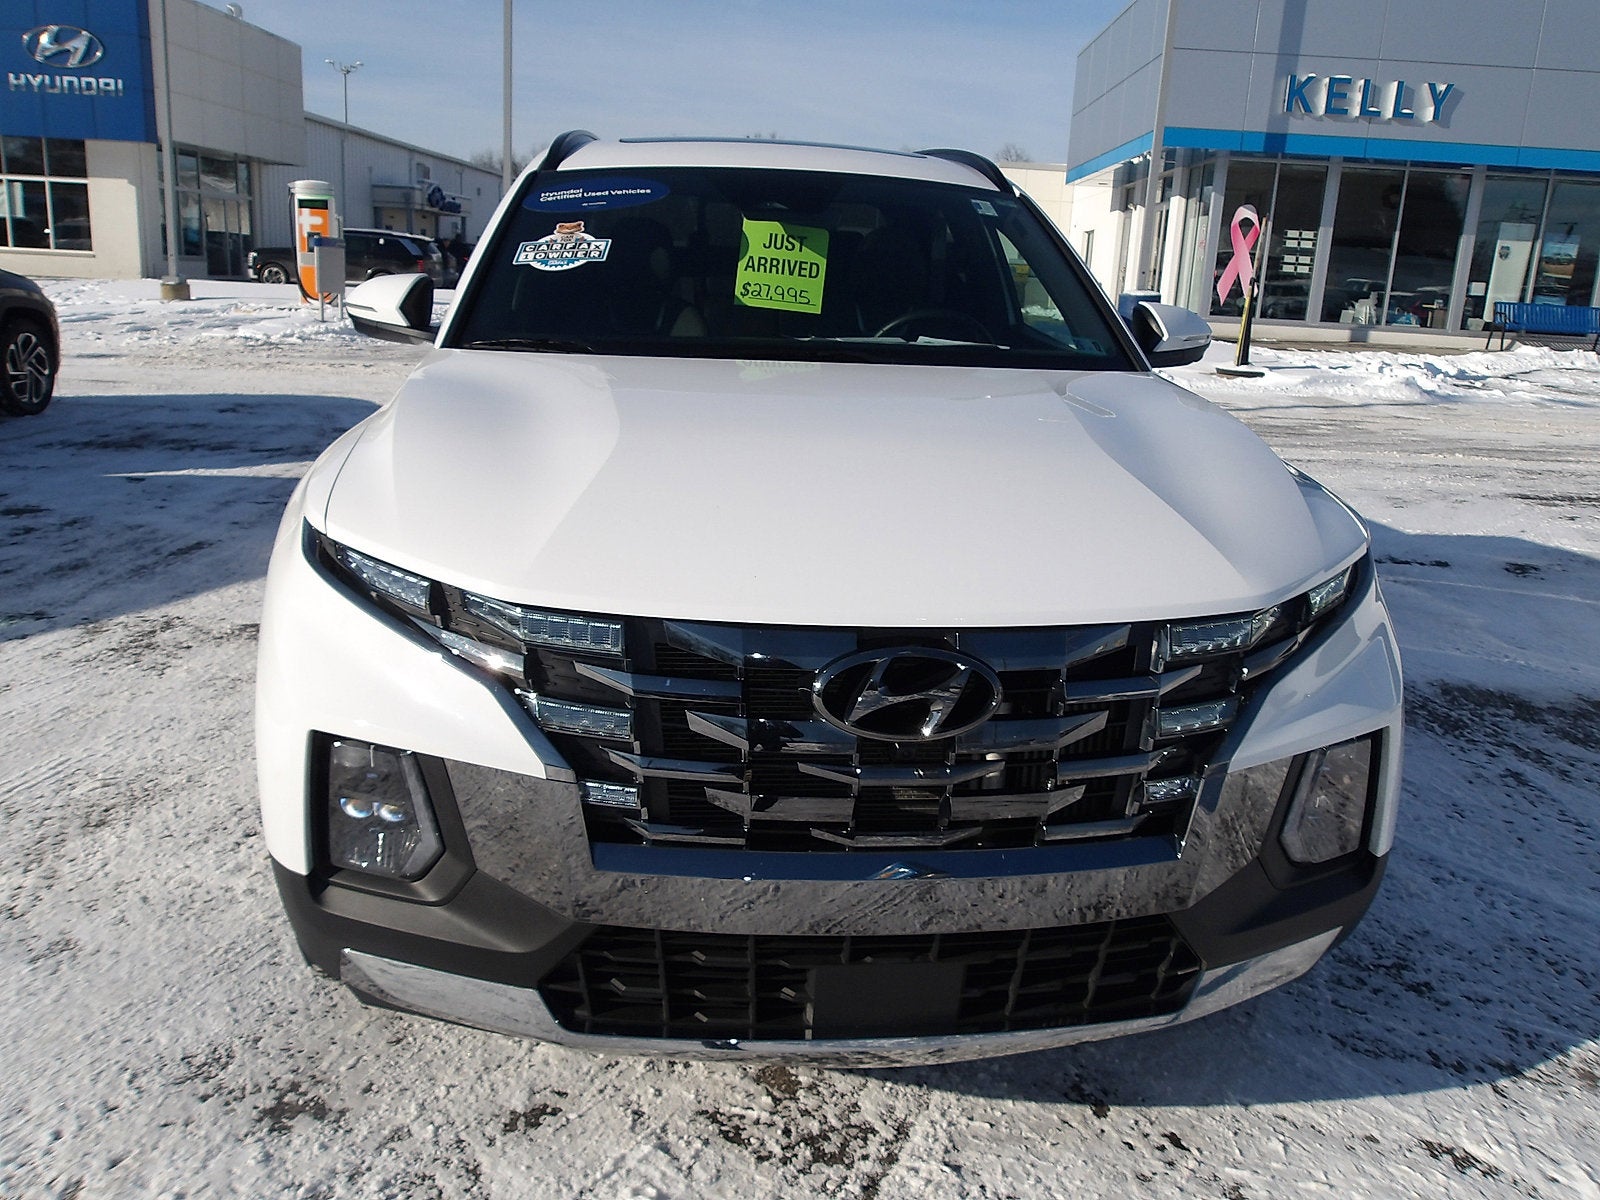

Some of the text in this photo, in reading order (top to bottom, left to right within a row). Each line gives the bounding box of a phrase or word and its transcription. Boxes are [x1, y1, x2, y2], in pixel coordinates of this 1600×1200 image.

[8, 72, 124, 97] HYUNDAI
[1283, 73, 1455, 121] KELLY
[540, 193, 582, 202] Certified
[541, 188, 583, 198] Hyundai
[524, 243, 602, 252] CARFAX
[763, 233, 807, 253] JUST
[535, 251, 600, 260] OWNER
[743, 255, 820, 279] ARRIVED
[740, 281, 811, 305] $27,995
